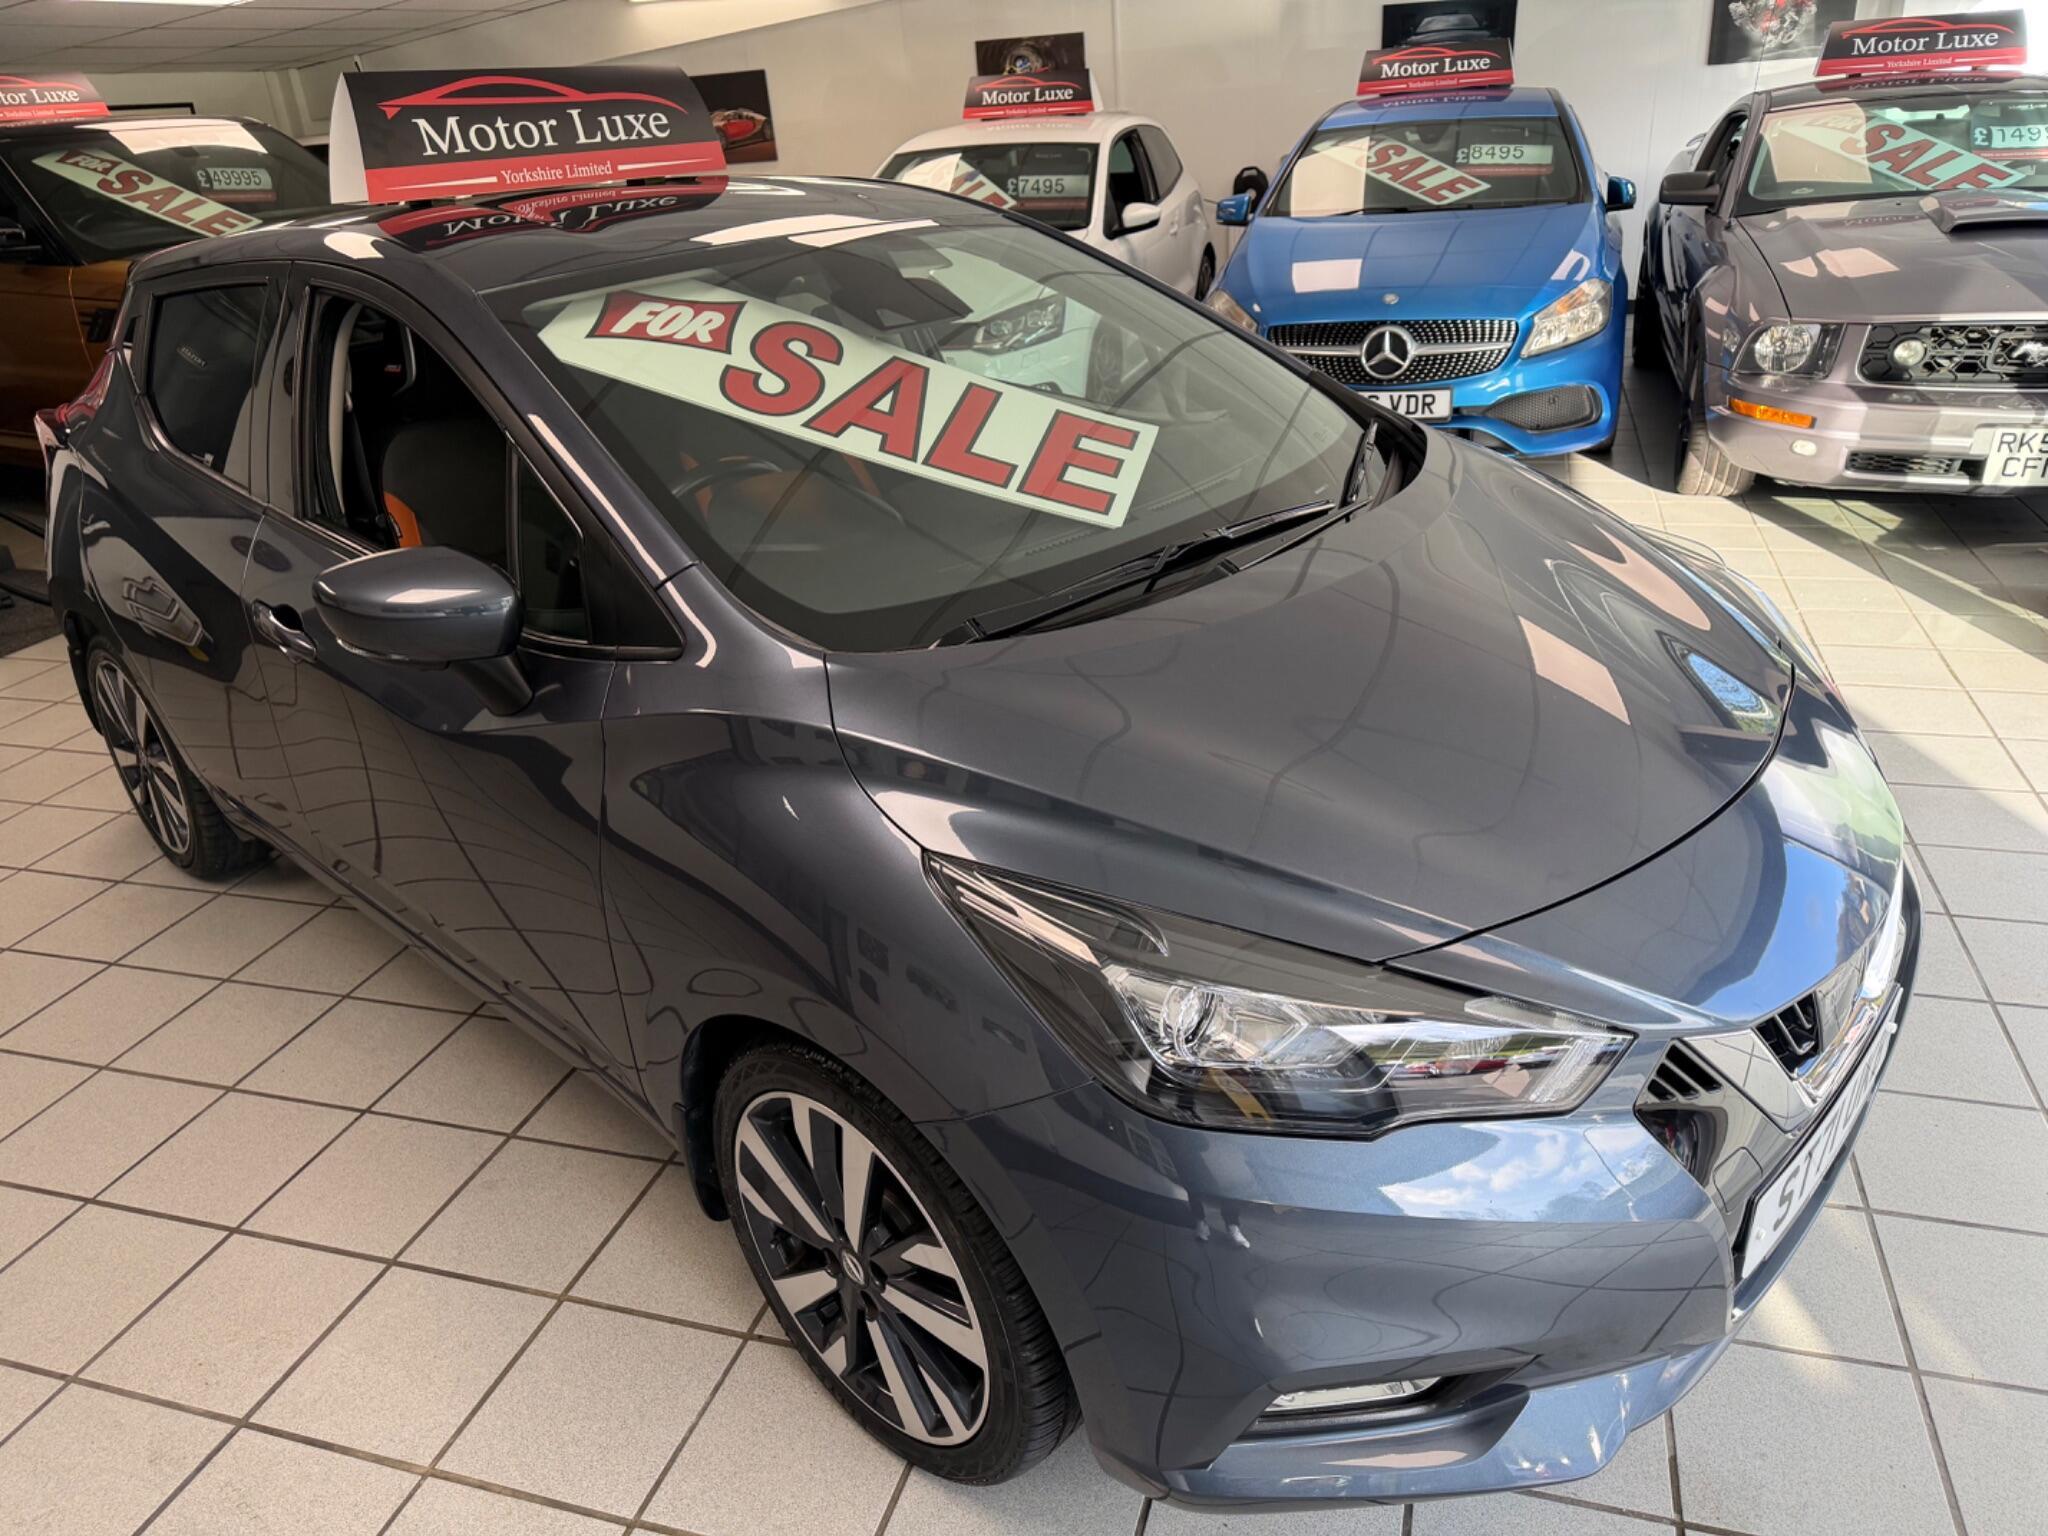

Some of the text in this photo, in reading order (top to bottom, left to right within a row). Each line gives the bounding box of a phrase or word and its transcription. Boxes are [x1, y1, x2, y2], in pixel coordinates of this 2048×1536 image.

[1851, 31, 2000, 56] Motor Luxe
[1380, 57, 1491, 79] Motor Luxe
[30, 88, 80, 103] Luxe
[981, 87, 1074, 105] Motor Luxe
[412, 108, 671, 156] Motor Luxe
[1974, 126, 2048, 145] £149
[1456, 145, 1525, 163] £8495
[1840, 124, 2012, 190] SALE
[197, 168, 263, 188] £49995
[501, 160, 613, 186] Yorkshire Limited
[1355, 143, 1482, 203] SALE
[68, 154, 250, 236] FOR SALE
[1007, 178, 1066, 196] £7495
[609, 301, 1141, 515] FOR SALE
[1389, 393, 1437, 416] VDR
